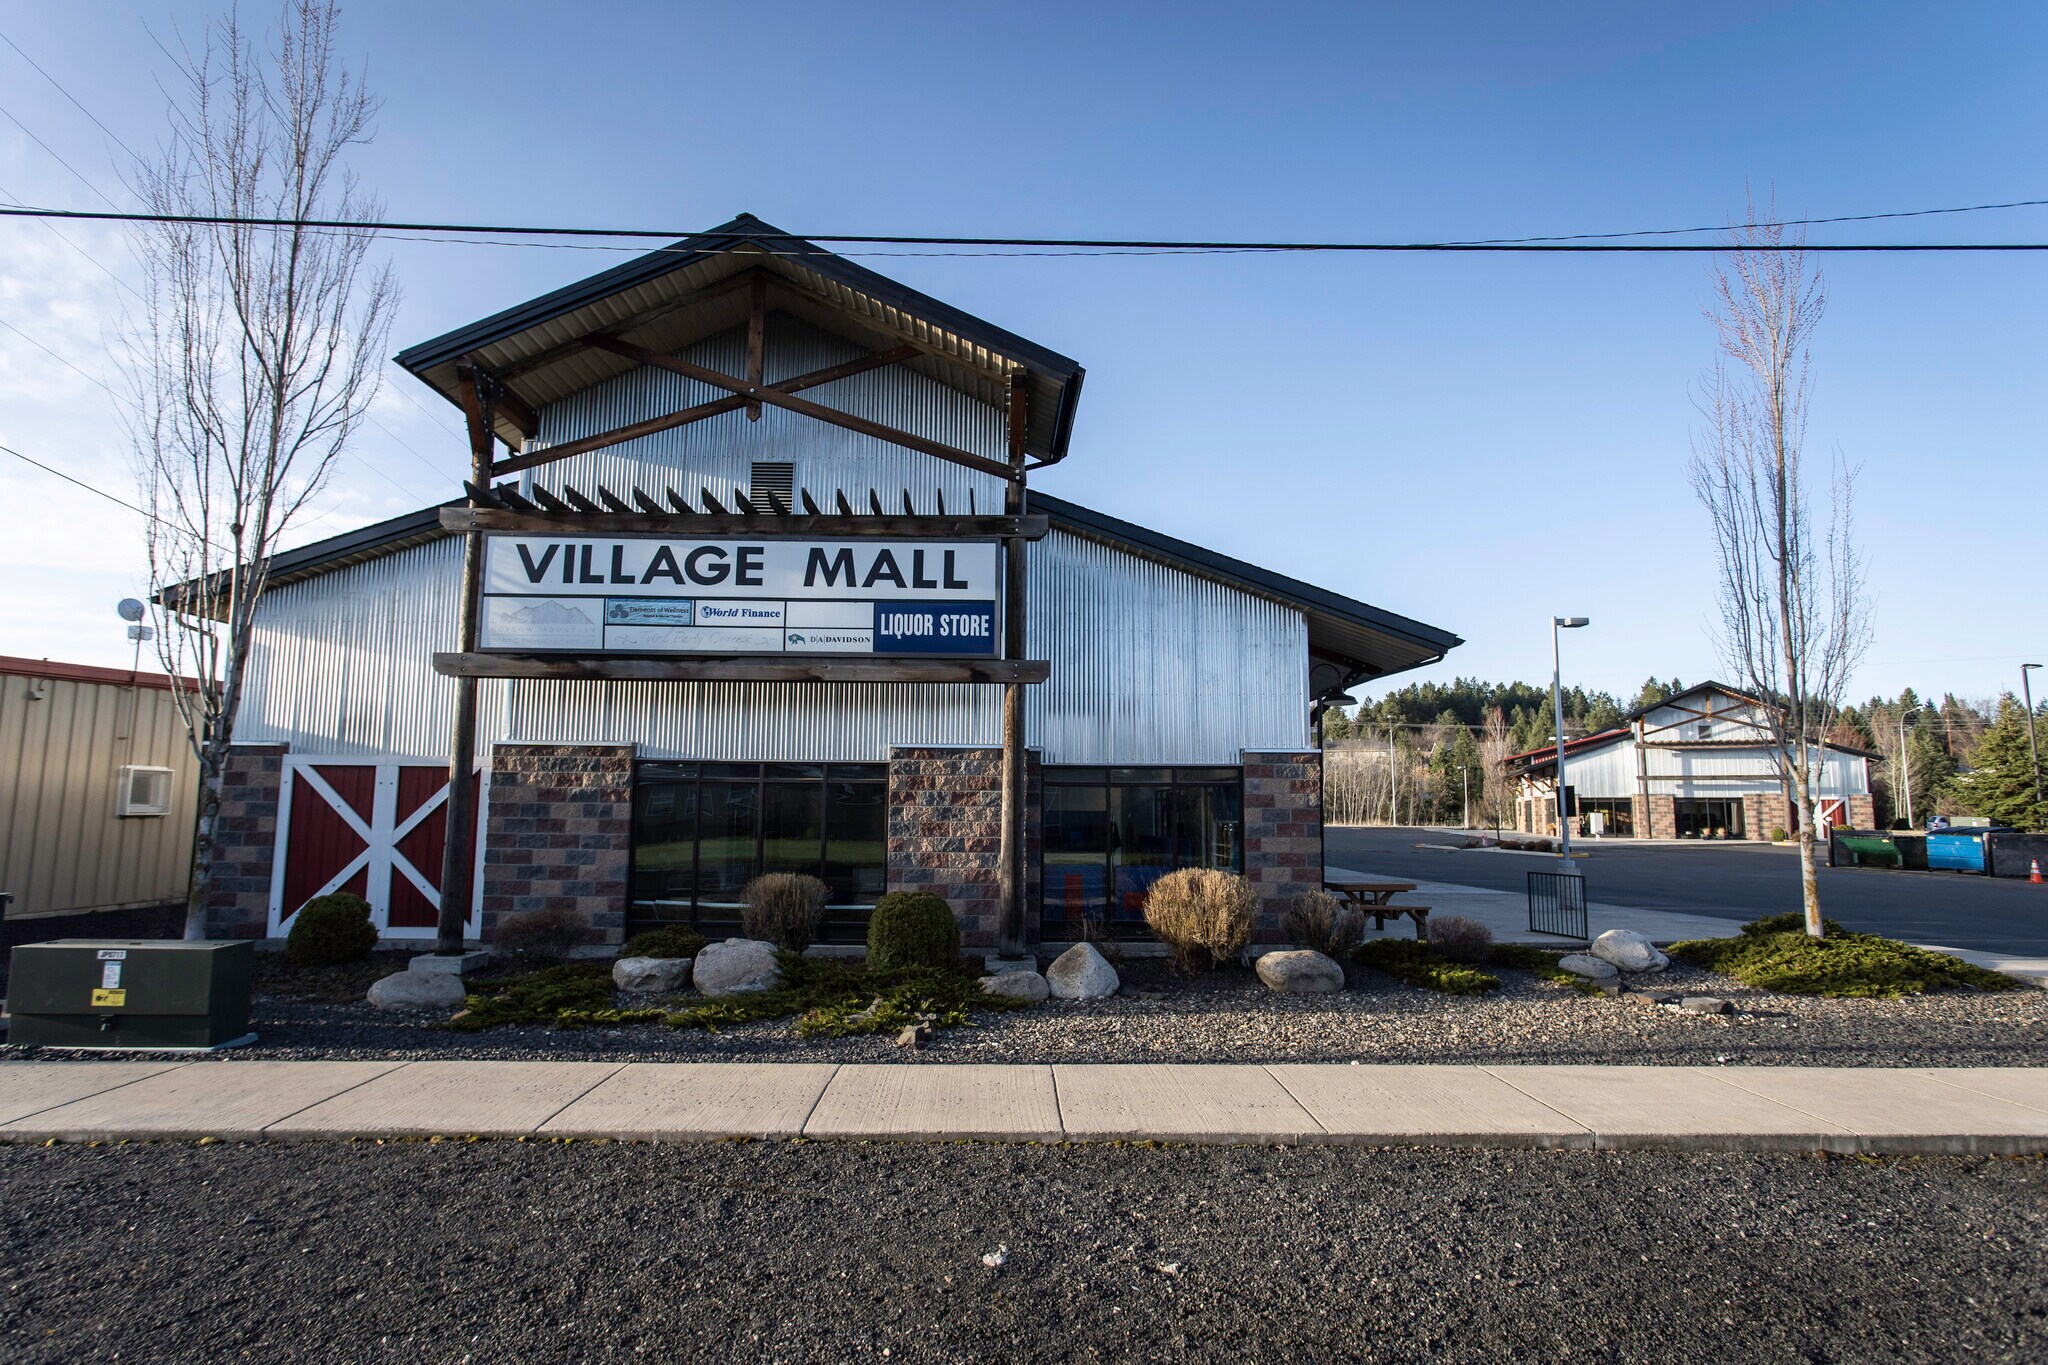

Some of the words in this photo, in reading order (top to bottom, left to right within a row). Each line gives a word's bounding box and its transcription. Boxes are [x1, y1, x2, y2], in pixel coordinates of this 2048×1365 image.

[516, 544, 764, 586] VILLAGE
[803, 547, 969, 589] MALL
[710, 607, 738, 617] World
[741, 608, 781, 618] Finance
[880, 613, 934, 639] LIQUOR
[940, 614, 990, 637] STORE
